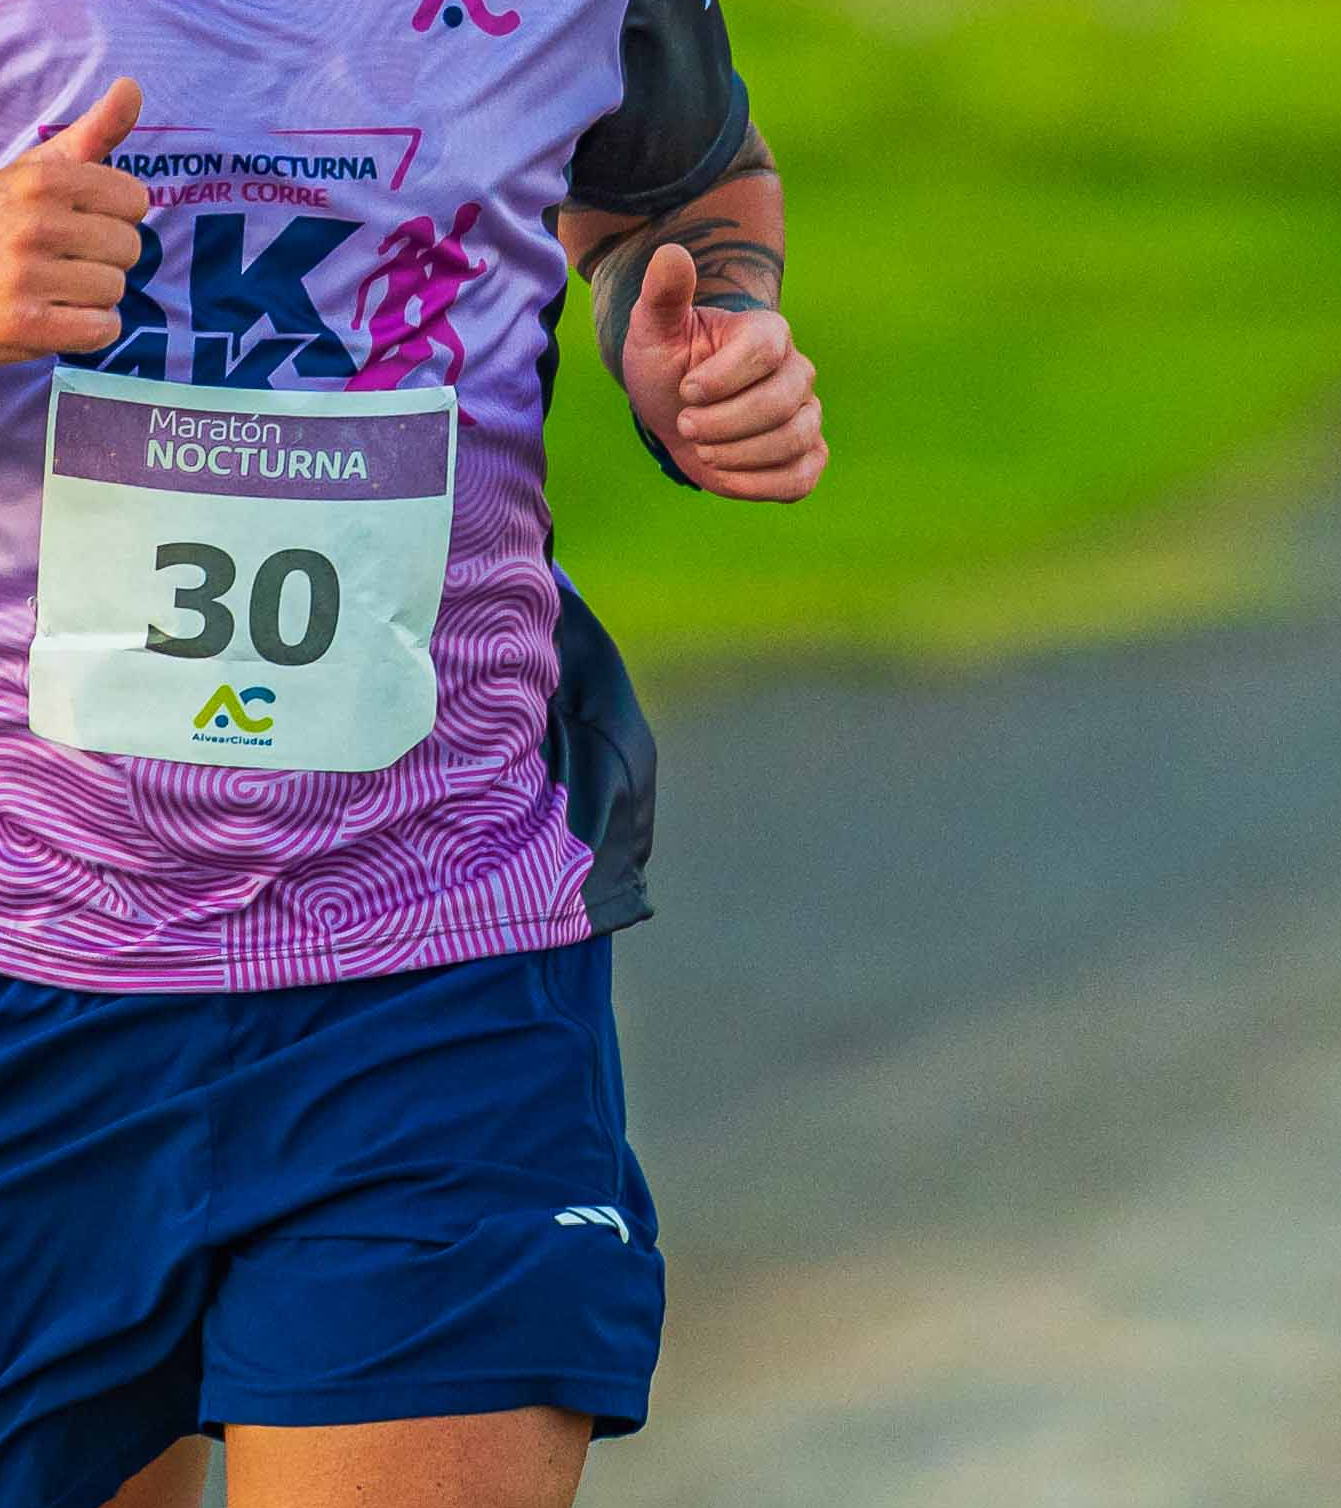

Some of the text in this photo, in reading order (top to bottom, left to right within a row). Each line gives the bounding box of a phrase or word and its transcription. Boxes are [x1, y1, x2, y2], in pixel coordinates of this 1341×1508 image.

[101, 153, 378, 180] ARATON NOCTURNA
[241, 183, 329, 208] CORRE
[149, 407, 281, 444] Maratón
[147, 439, 368, 480] NOCTURNA
[145, 542, 340, 666] 30
[192, 733, 273, 746] AlvearCiudad
